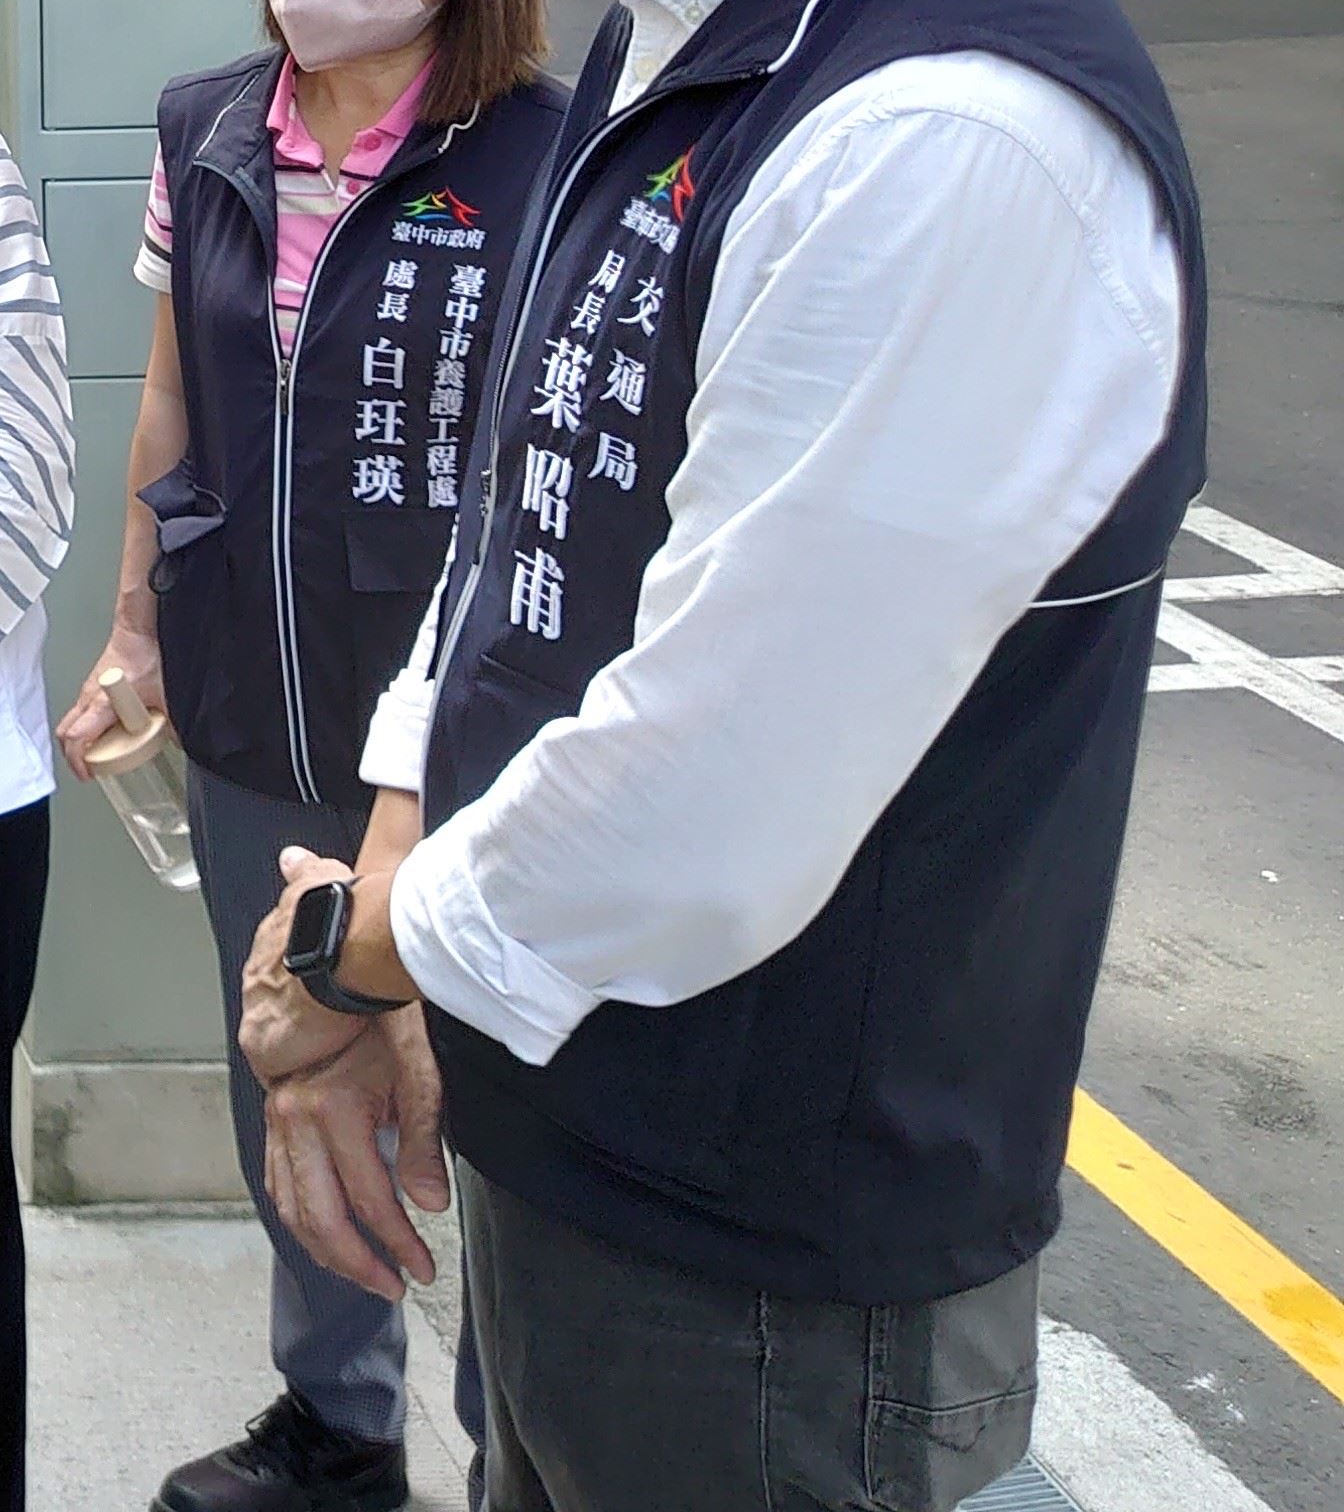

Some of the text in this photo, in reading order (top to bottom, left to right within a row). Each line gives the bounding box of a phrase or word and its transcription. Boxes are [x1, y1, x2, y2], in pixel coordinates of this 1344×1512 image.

[390, 220, 486, 251] 臺中市政府
[425, 262, 488, 510] 臺中市養護工程處
[586, 275, 666, 493] 交通局
